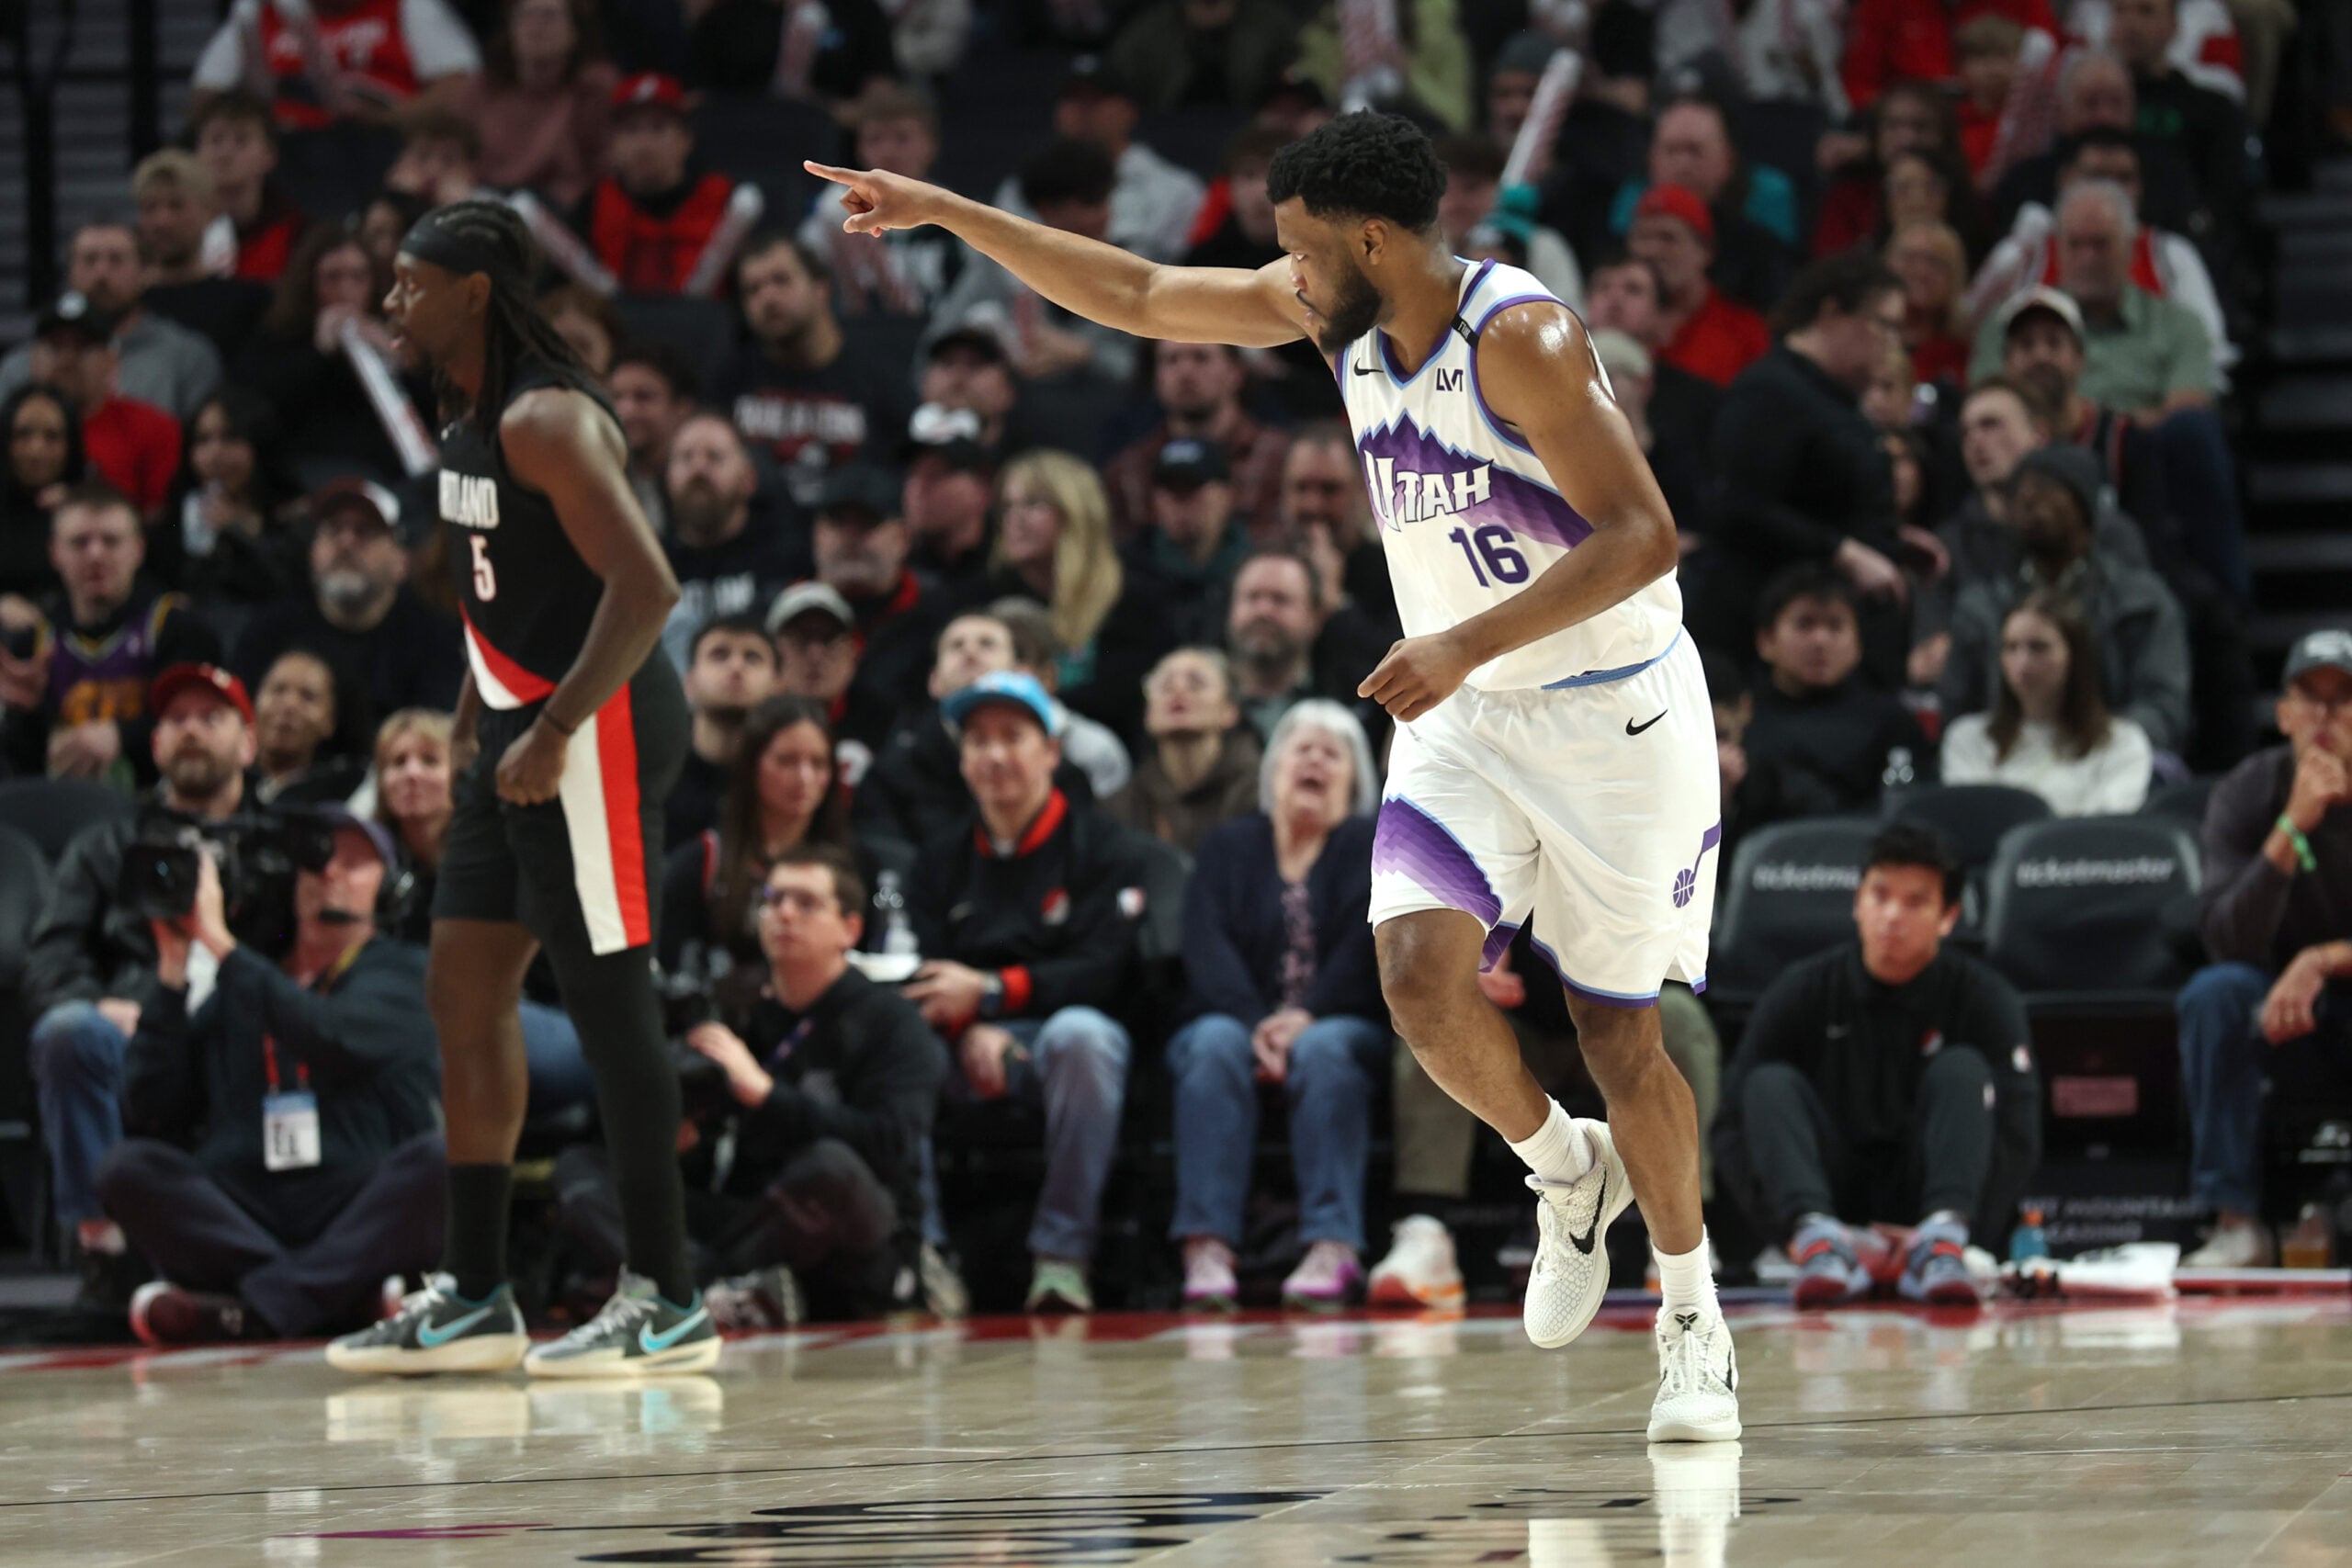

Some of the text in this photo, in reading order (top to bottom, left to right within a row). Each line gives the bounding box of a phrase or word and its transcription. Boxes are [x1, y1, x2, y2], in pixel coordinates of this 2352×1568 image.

[469, 533, 497, 603] 5
[1448, 524, 1531, 588] 16
[2017, 857, 2174, 888] ticketmaster
